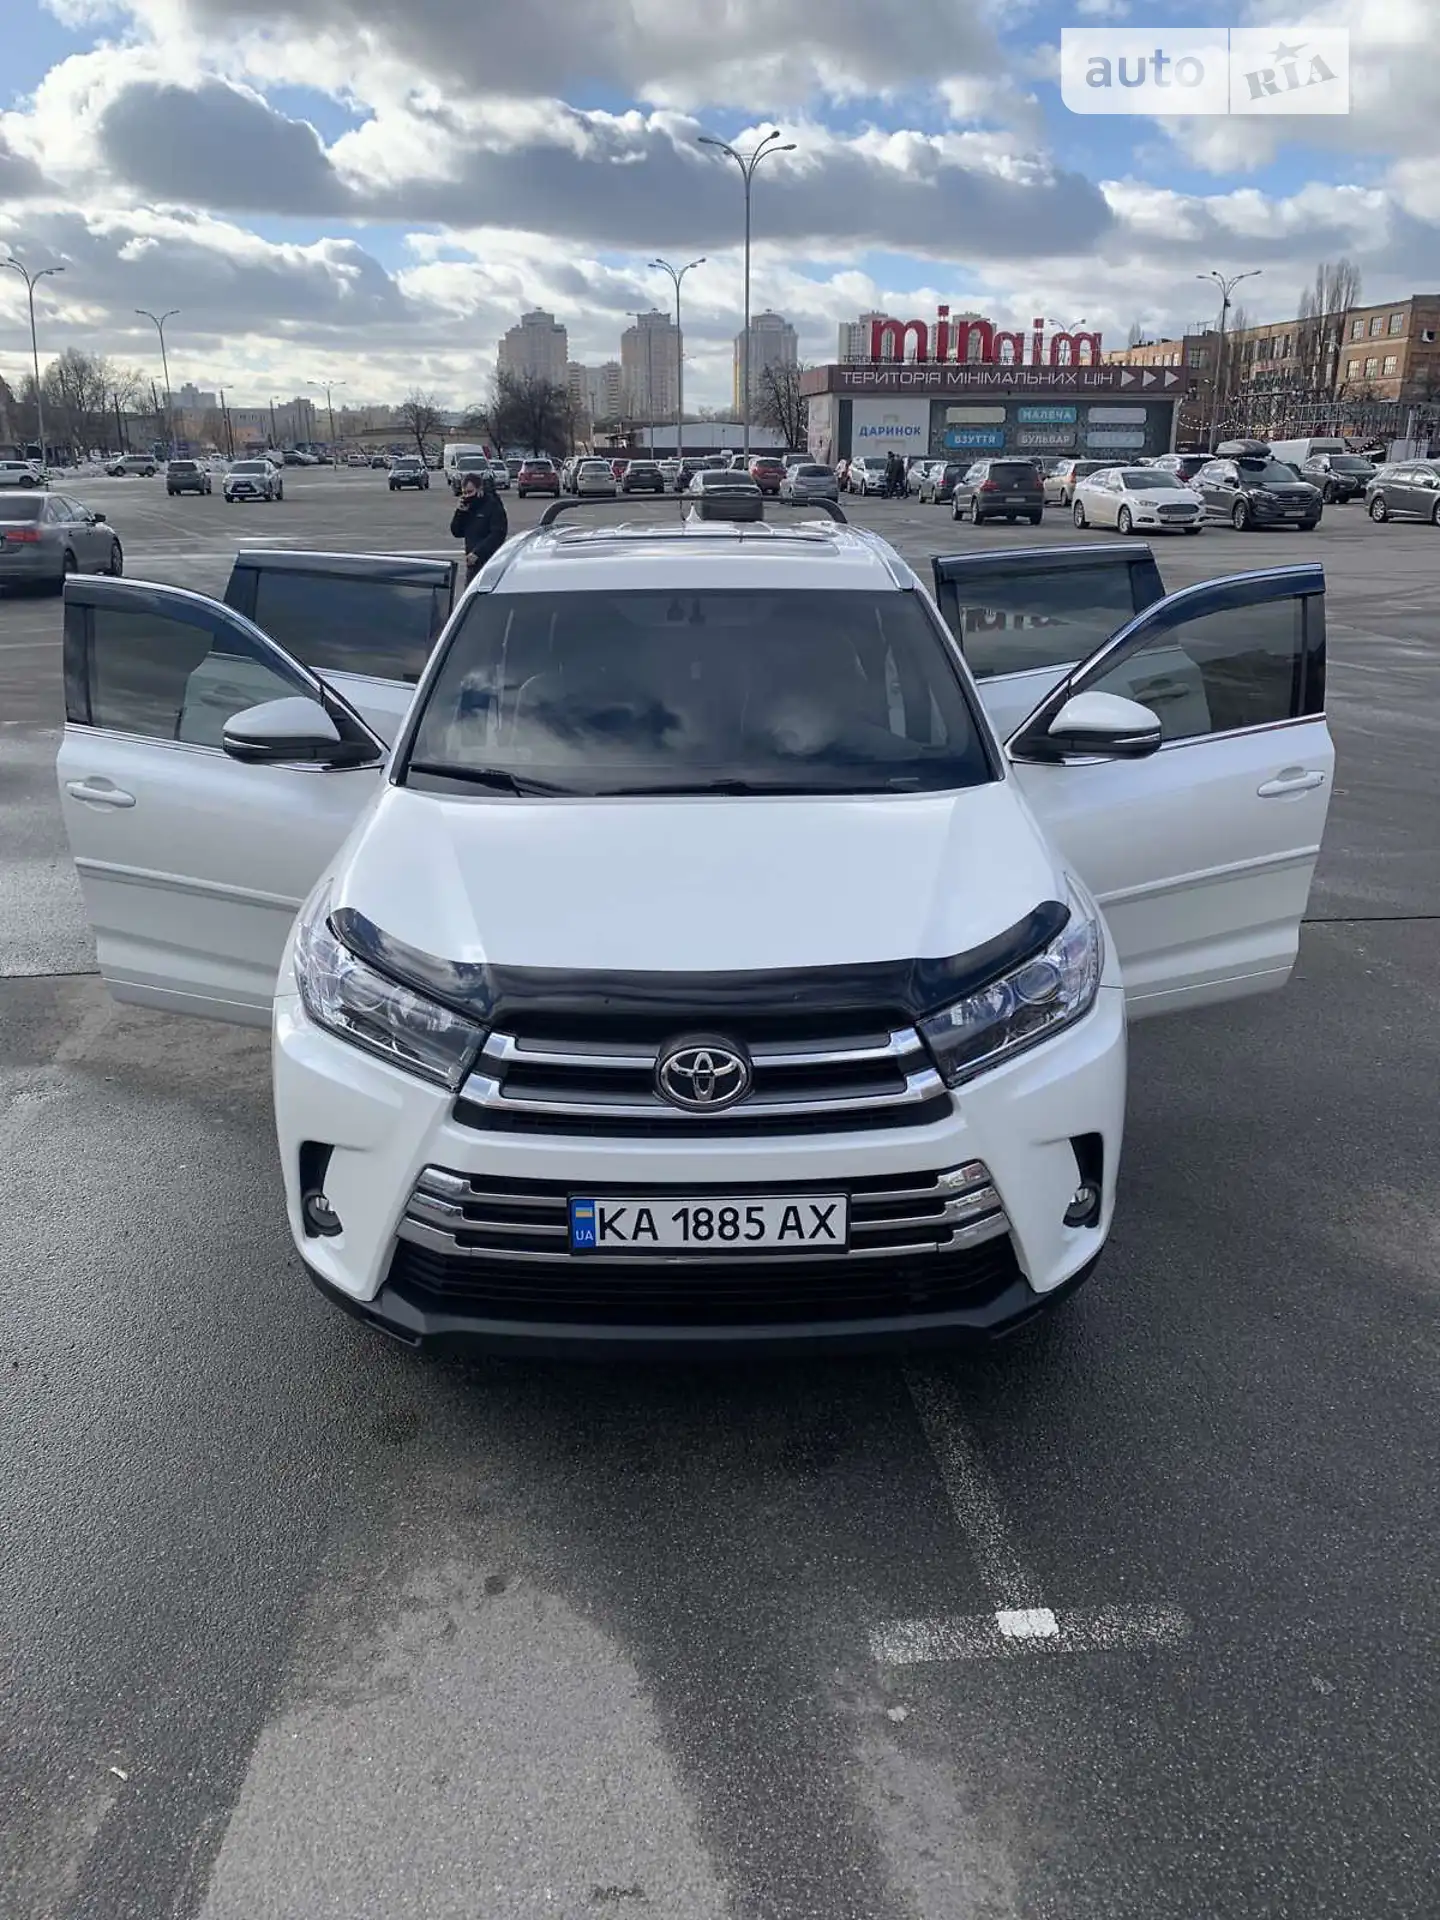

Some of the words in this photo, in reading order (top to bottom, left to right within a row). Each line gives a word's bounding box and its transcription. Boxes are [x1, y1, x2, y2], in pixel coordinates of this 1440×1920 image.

[841, 371, 941, 386] ТЕРИТОРІЯ
[947, 371, 1077, 386] МІНІМАЛЬНИХ
[1084, 371, 1114, 387] ЦІН
[859, 425, 921, 437] ДАРИНОК
[954, 434, 996, 445] ВЗУТТЯ
[1020, 433, 1070, 445] БУЛЬВАР
[599, 1207, 659, 1241] KA
[671, 1206, 766, 1241] 1885
[777, 1204, 838, 1240] AX
[575, 1229, 594, 1242] UA
